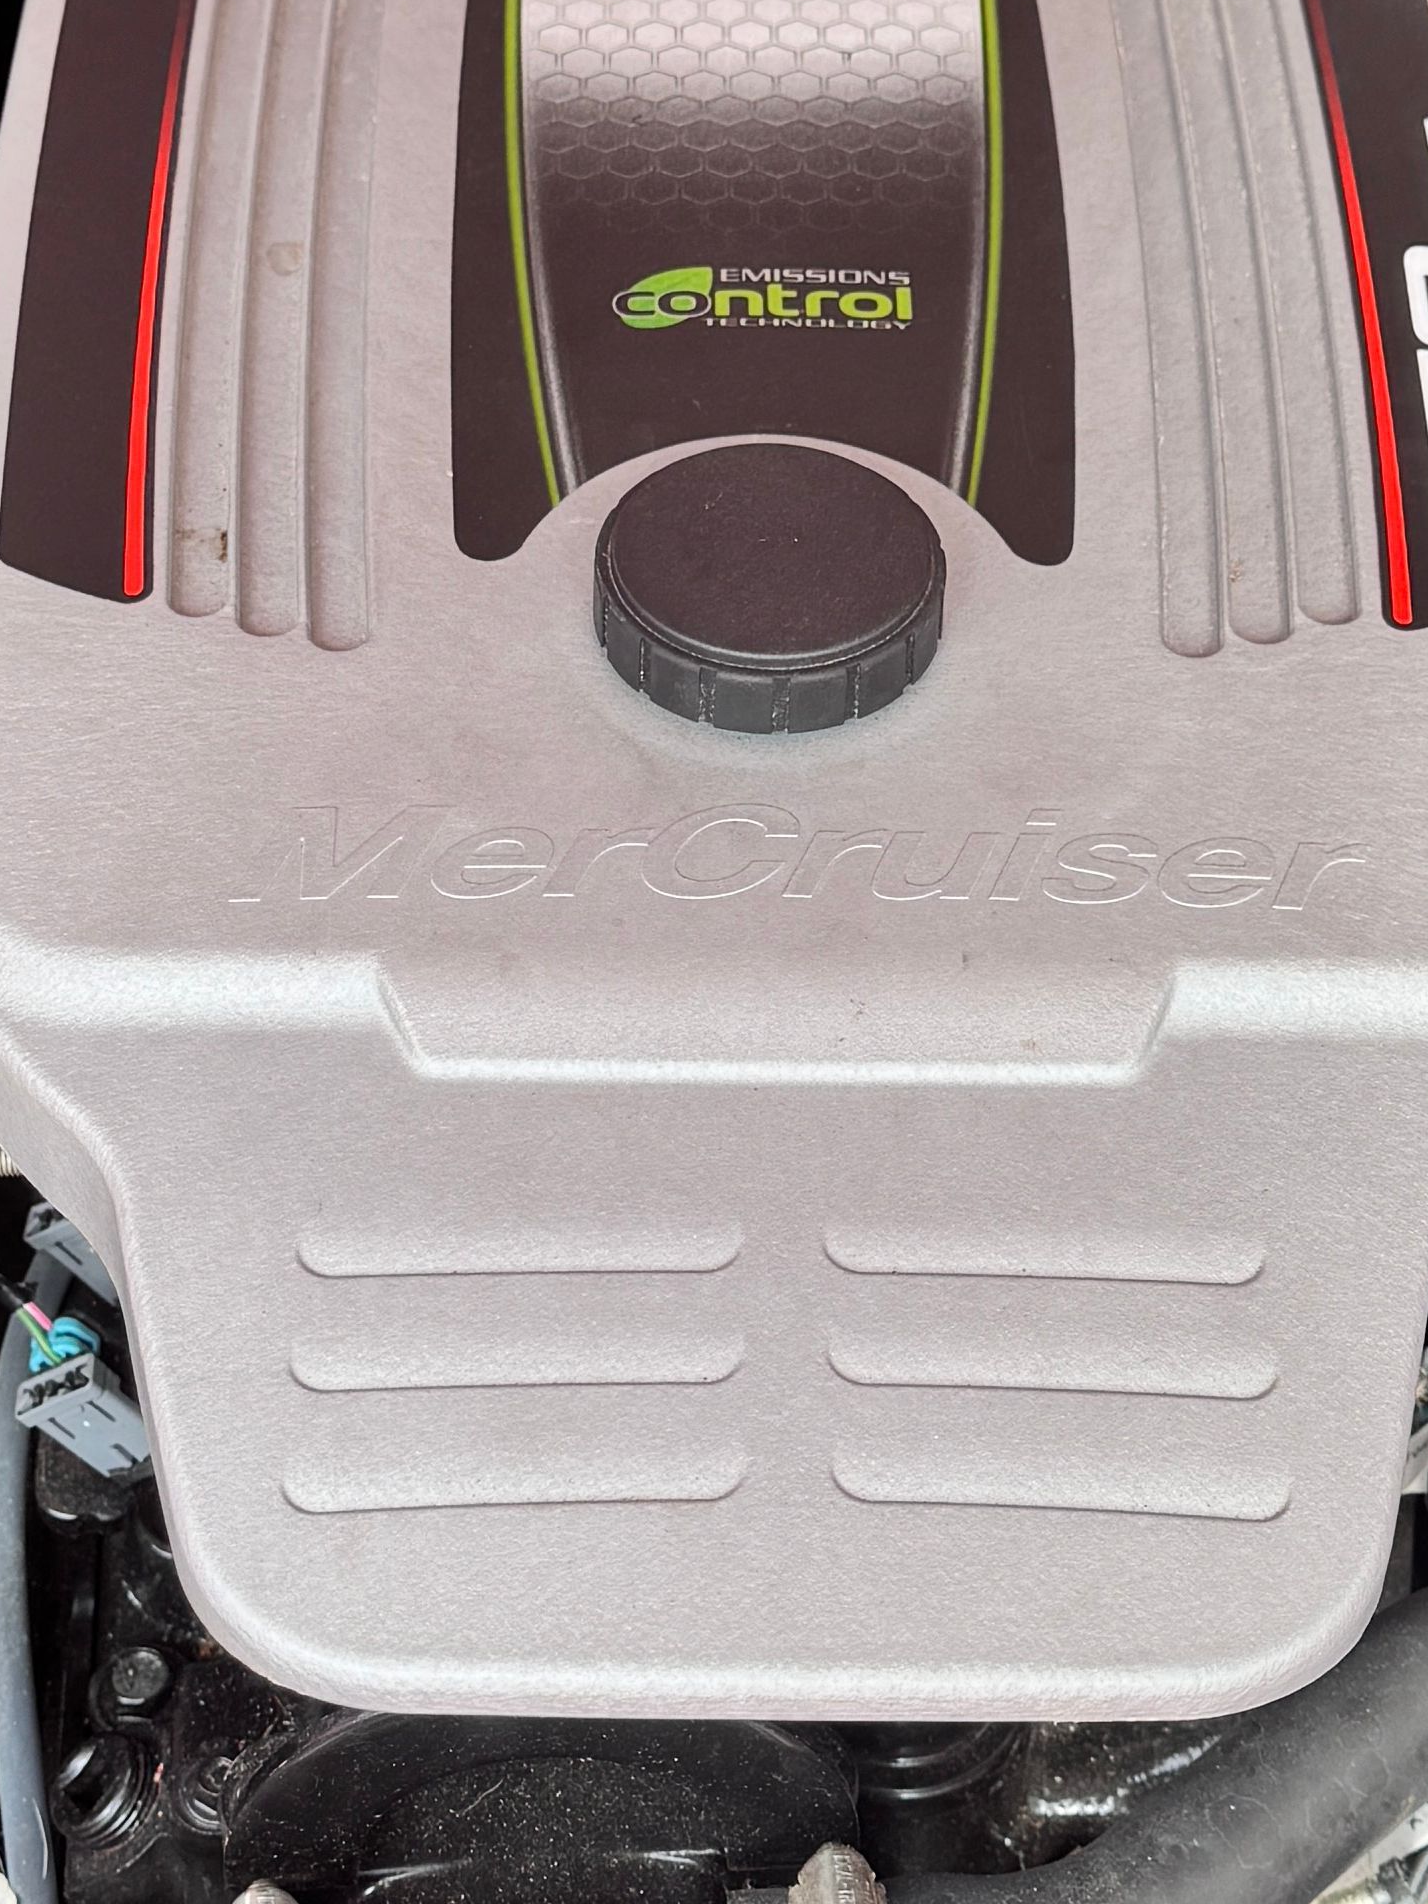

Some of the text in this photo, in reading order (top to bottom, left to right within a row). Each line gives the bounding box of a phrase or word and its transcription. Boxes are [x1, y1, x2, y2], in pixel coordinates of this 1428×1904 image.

[720, 268, 911, 286] EMISSIONS
[705, 318, 910, 330] TECHNOLOGY
[229, 803, 1366, 911] MerCruiser
